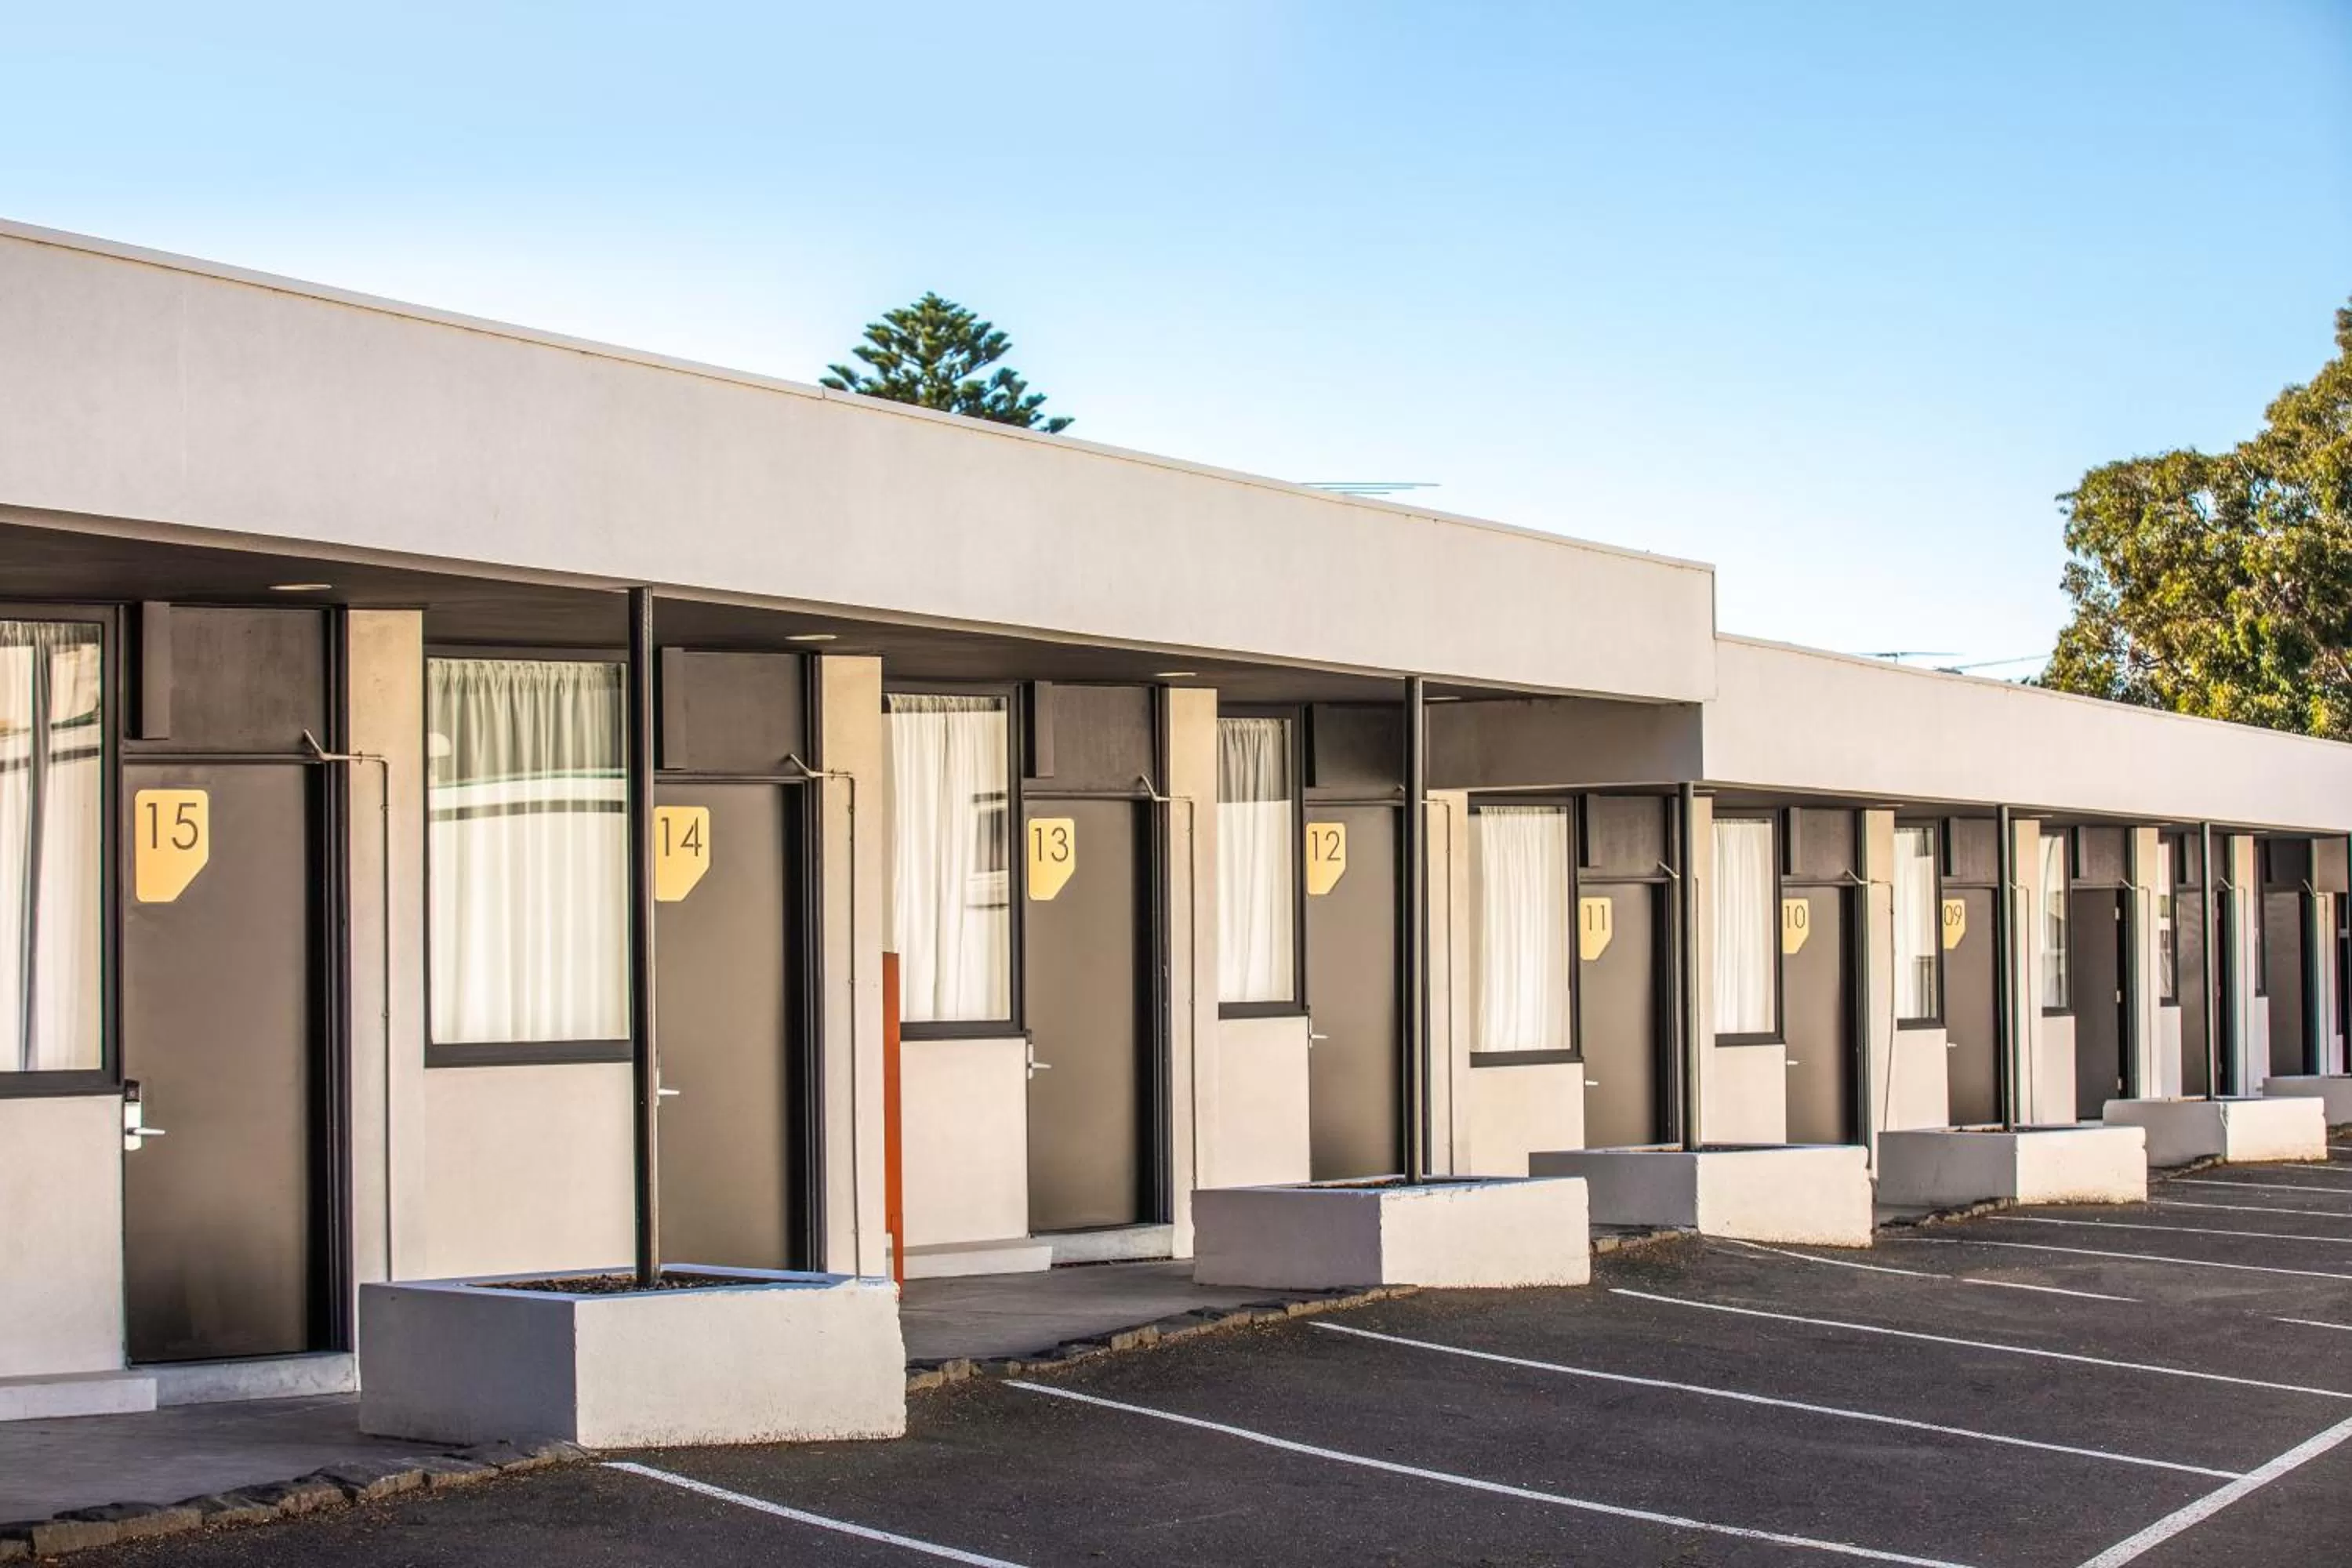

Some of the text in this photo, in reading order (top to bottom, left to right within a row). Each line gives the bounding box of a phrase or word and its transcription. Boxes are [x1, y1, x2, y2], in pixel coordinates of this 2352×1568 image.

[146, 802, 199, 850] 15
[660, 816, 703, 858] 14
[1033, 827, 1069, 862] 13
[1311, 830, 1341, 862] 12
[1586, 904, 1606, 931] 11
[1784, 905, 1806, 928] 10
[1944, 904, 1962, 927] 09
